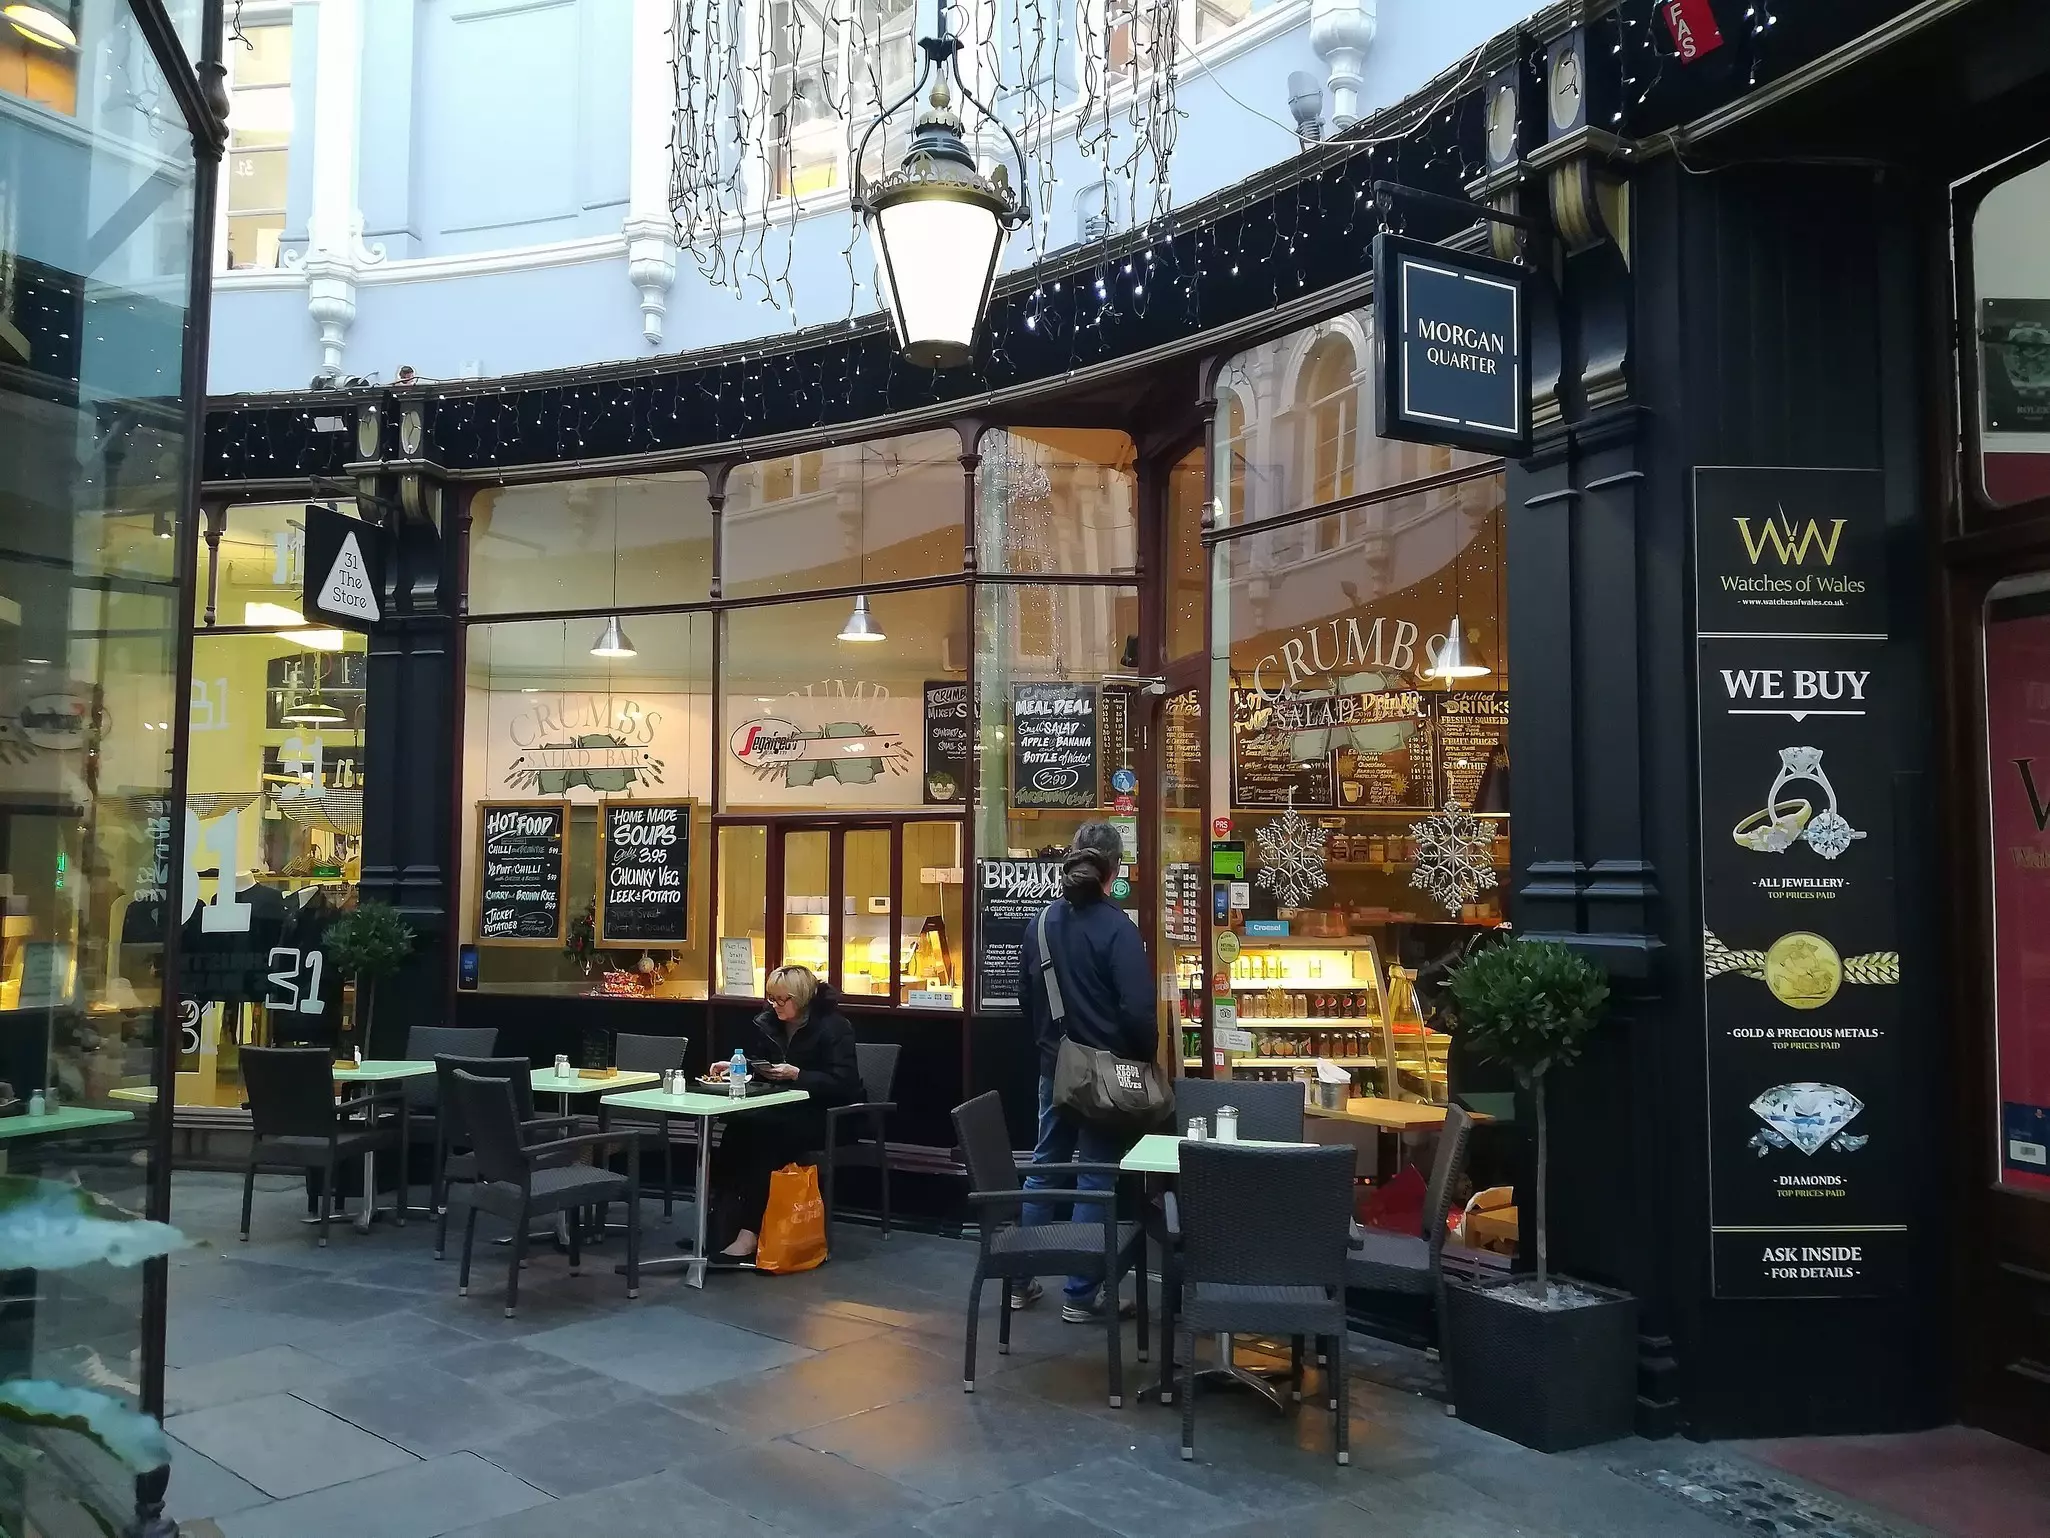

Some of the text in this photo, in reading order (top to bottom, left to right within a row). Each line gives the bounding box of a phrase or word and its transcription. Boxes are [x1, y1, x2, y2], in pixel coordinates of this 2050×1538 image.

[1418, 317, 1504, 355] MORGAN
[1426, 347, 1497, 375] QUARTER
[344, 552, 358, 570] 31
[338, 569, 363, 589] The
[1720, 574, 1866, 593] Watches of Wales
[332, 586, 367, 609] Store
[1742, 598, 1844, 607] www.watchesofwales.co.uk
[1254, 616, 1450, 701] CRUMBS
[1719, 669, 1871, 700] WE BUY
[1453, 691, 1496, 701] Chilled
[1015, 698, 1093, 716] MEAL DEAL
[1440, 700, 1510, 714] DRINKS
[509, 695, 663, 747] CRUMBS
[1441, 716, 1474, 725] FRESHLY
[1043, 721, 1080, 736] SALAD
[1021, 737, 1050, 747] APPLE
[1055, 736, 1092, 747] BANANA
[526, 749, 641, 768] SALAD BAR
[1021, 750, 1058, 765] BOTTLE
[487, 812, 553, 836] HOT FOOD
[1215, 820, 1229, 829] PRS
[613, 824, 677, 846] SOUPS
[487, 844, 512, 855] CHILLI
[638, 847, 668, 864] 3.95
[610, 866, 657, 888] CHUNKY
[1758, 878, 1845, 888] ALL JEWELLERY
[516, 889, 541, 901] BROWN
[609, 889, 636, 904] LEEK
[641, 889, 681, 904] POTATO
[1767, 891, 1836, 899] TOP PRICES PAID
[485, 908, 515, 925] JACKET
[484, 920, 518, 934] POTATOES
[265, 947, 326, 1015] 31
[1733, 1028, 1879, 1038] GOLD & PRECIOUS METALS
[1772, 1042, 1841, 1050] TOP PRICES PAID
[1115, 1064, 1139, 1073] HEADS
[1116, 1070, 1140, 1078] ABOVE
[1119, 1081, 1142, 1089] WAVES
[1779, 1175, 1842, 1185] DIAMONDS
[1776, 1189, 1846, 1197] TOP PRICES PAID
[1762, 1247, 1862, 1262] ASK INSIDE
[1771, 1267, 1854, 1278] FOR DETAILS
